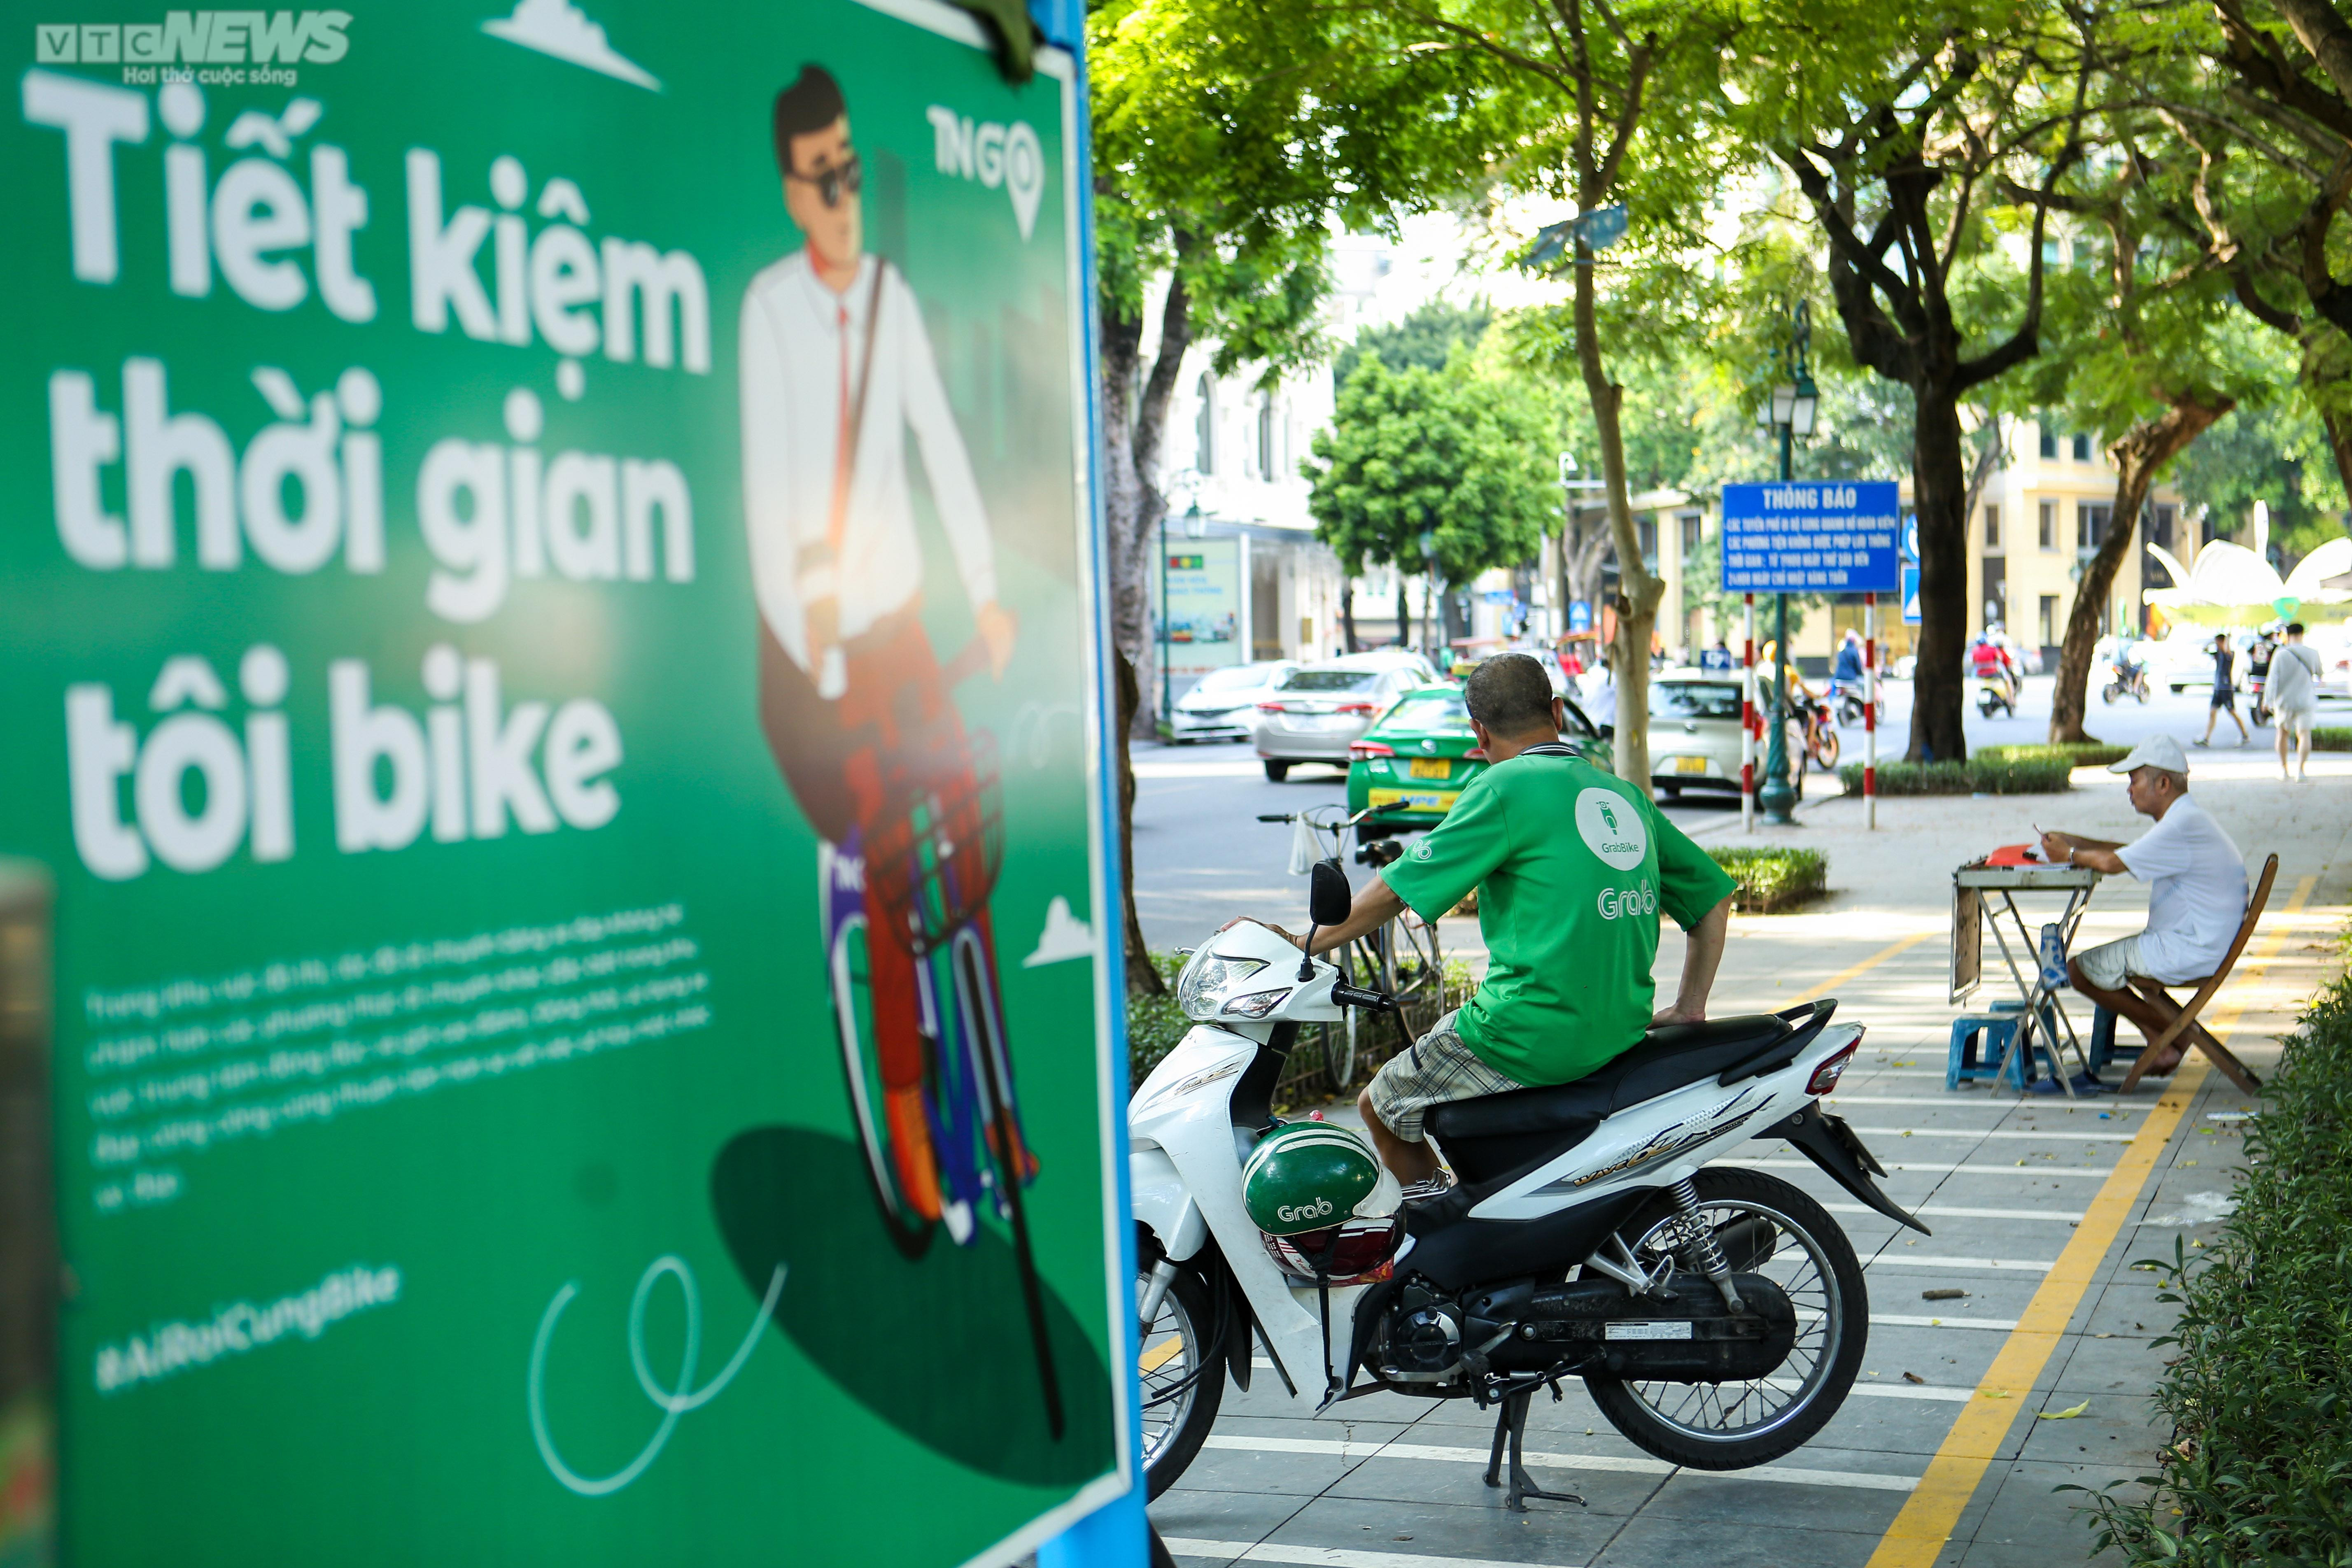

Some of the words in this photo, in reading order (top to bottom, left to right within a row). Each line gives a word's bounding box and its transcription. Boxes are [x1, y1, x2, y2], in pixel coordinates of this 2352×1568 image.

[21, 69, 376, 323] Tiết
[408, 147, 710, 401] kiệm
[49, 357, 386, 575] thời
[419, 388, 694, 622] gian
[1762, 483, 1818, 510] THÔNG
[1822, 482, 1857, 509] BÁO
[65, 644, 296, 881] tôi
[328, 643, 622, 853] bike
[1601, 842, 1640, 853] GrabBike
[1597, 879, 1656, 920] Grab
[1277, 1197, 1333, 1222] Grab
